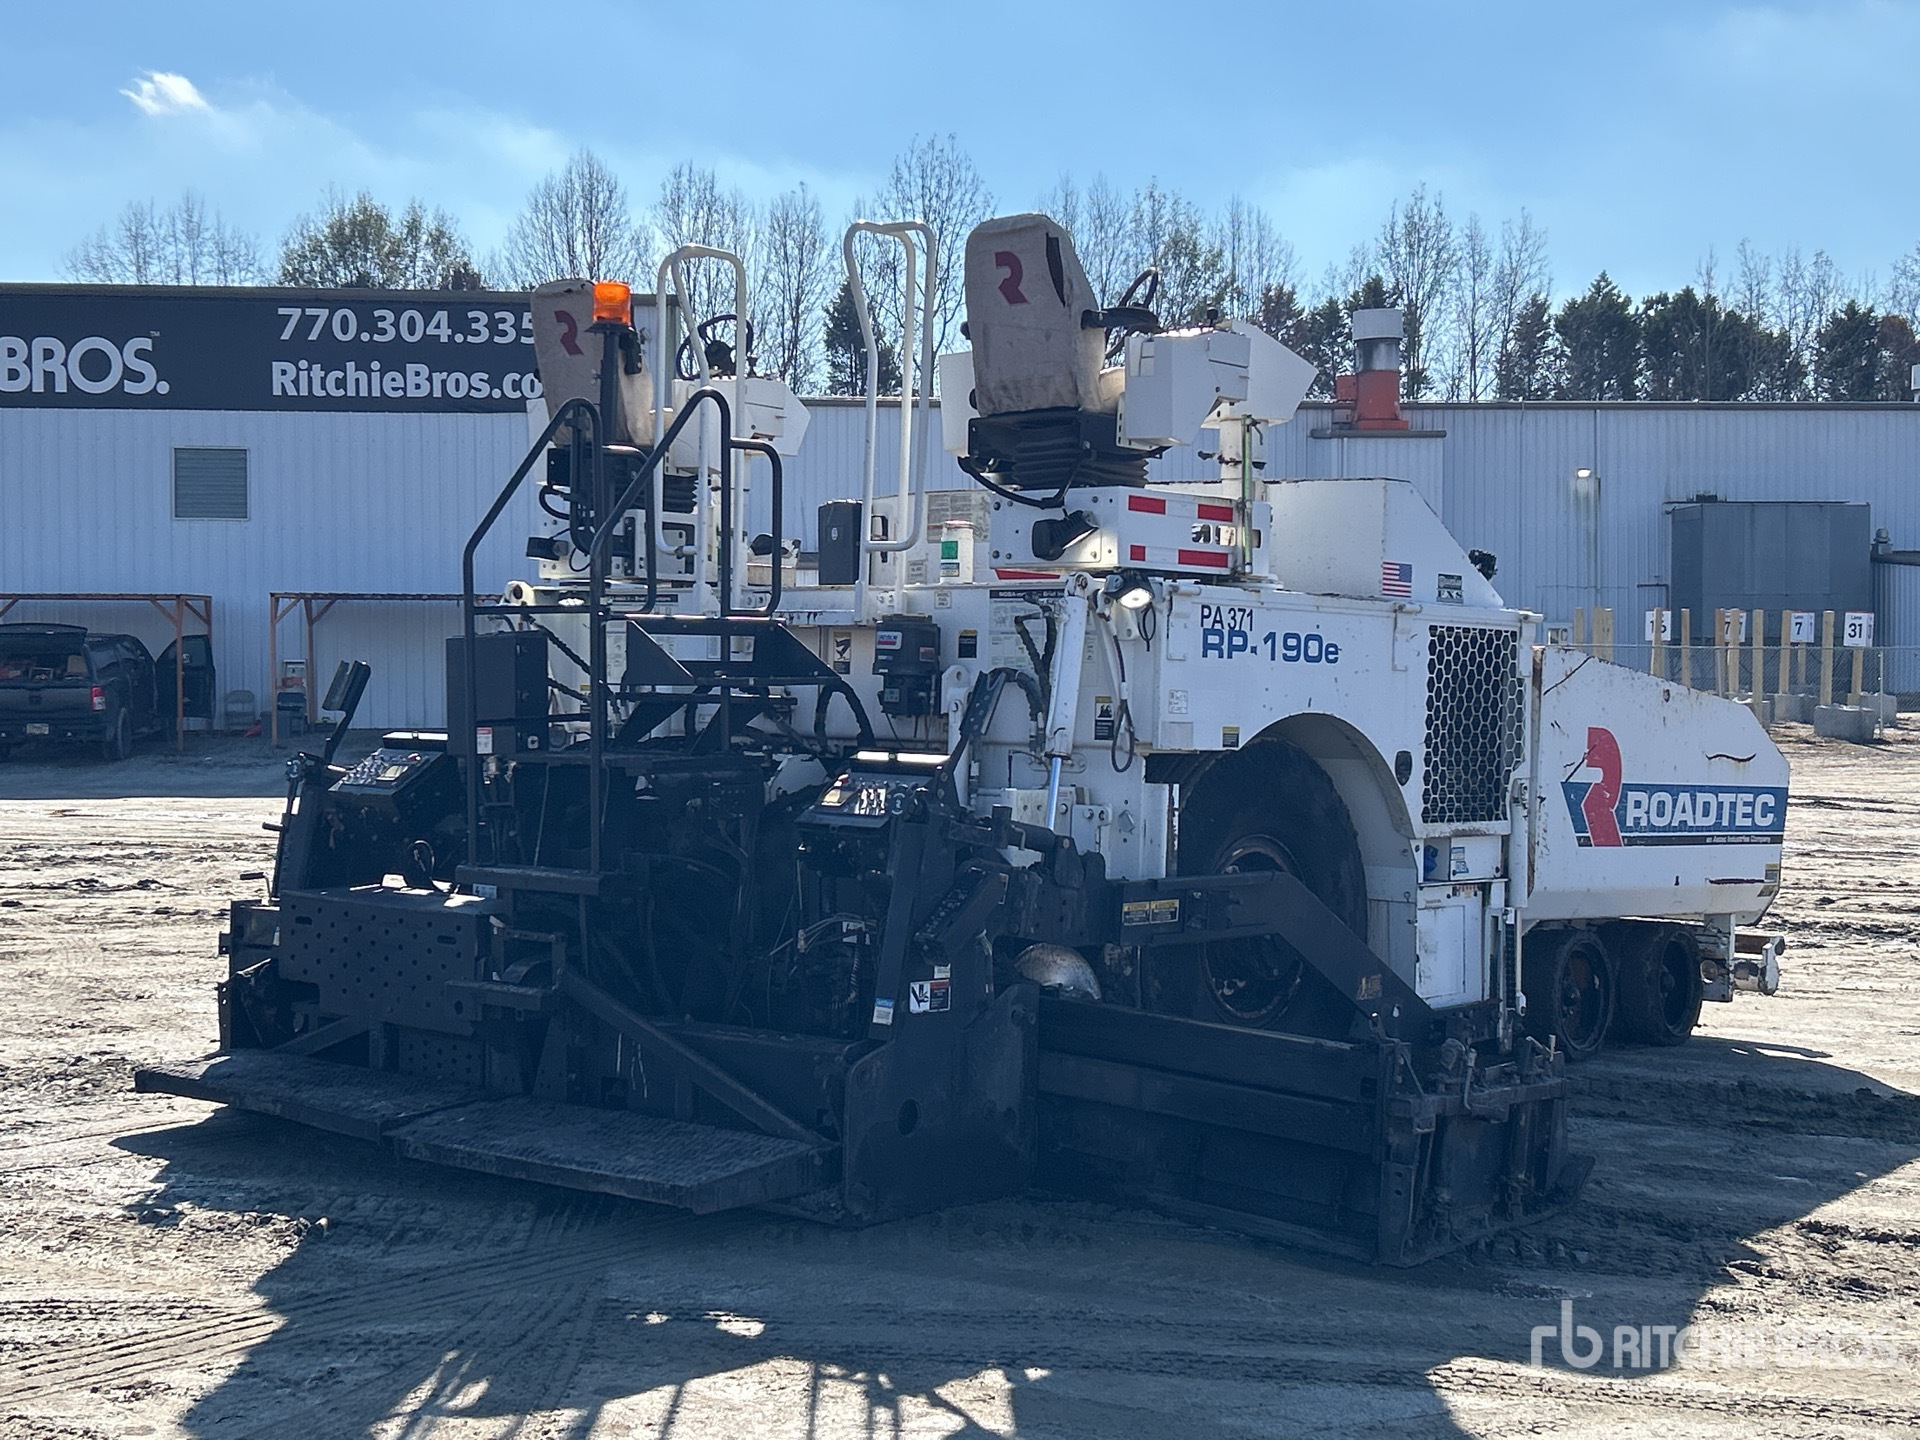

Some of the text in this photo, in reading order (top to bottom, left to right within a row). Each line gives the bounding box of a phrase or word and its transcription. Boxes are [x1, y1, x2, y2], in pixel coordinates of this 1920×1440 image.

[0, 336, 170, 395] BROS.
[1201, 628, 1340, 664] RP-190e
[1794, 622, 1803, 635] 7
[1848, 622, 1863, 639] 31
[1625, 791, 1776, 827] ROADTEC
